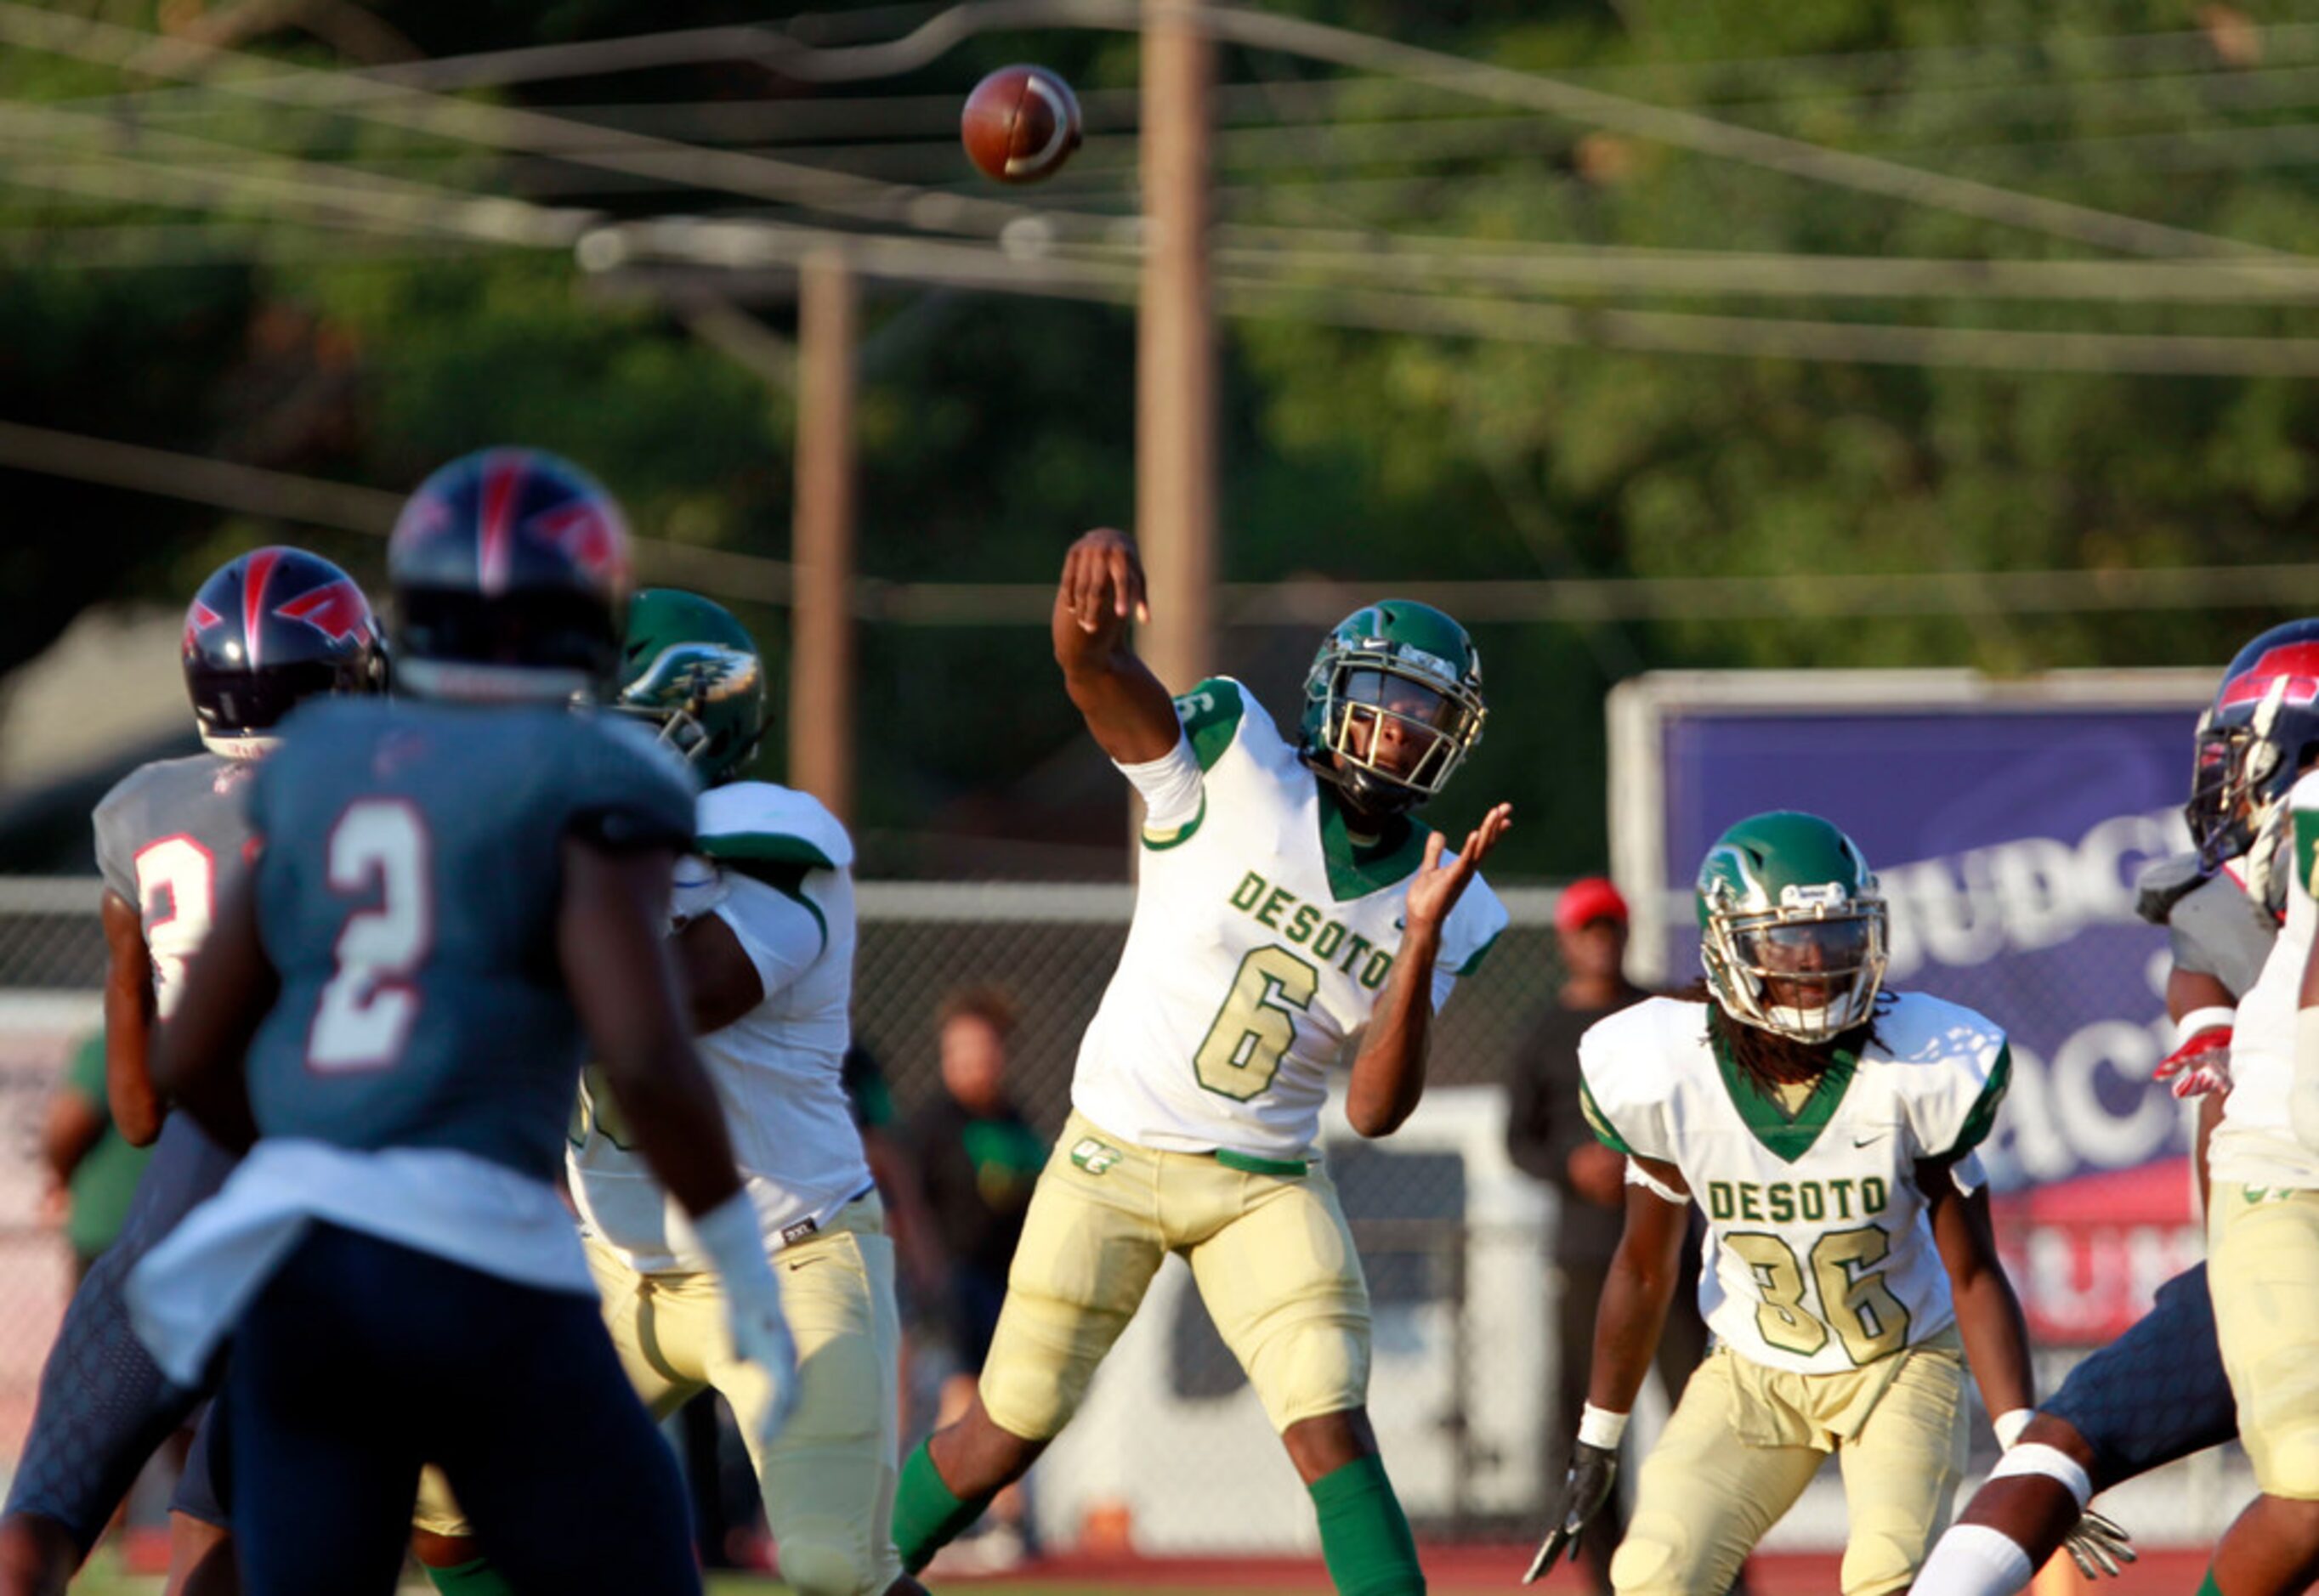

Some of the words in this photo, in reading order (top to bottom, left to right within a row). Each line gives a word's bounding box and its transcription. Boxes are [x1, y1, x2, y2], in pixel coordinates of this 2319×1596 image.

[303, 795, 432, 1072] 2
[1229, 870, 1394, 990] DESOTO
[1194, 943, 1318, 1103] 6
[1708, 1176, 1888, 1224] DESOTO
[1723, 1223, 1911, 1367] 36
